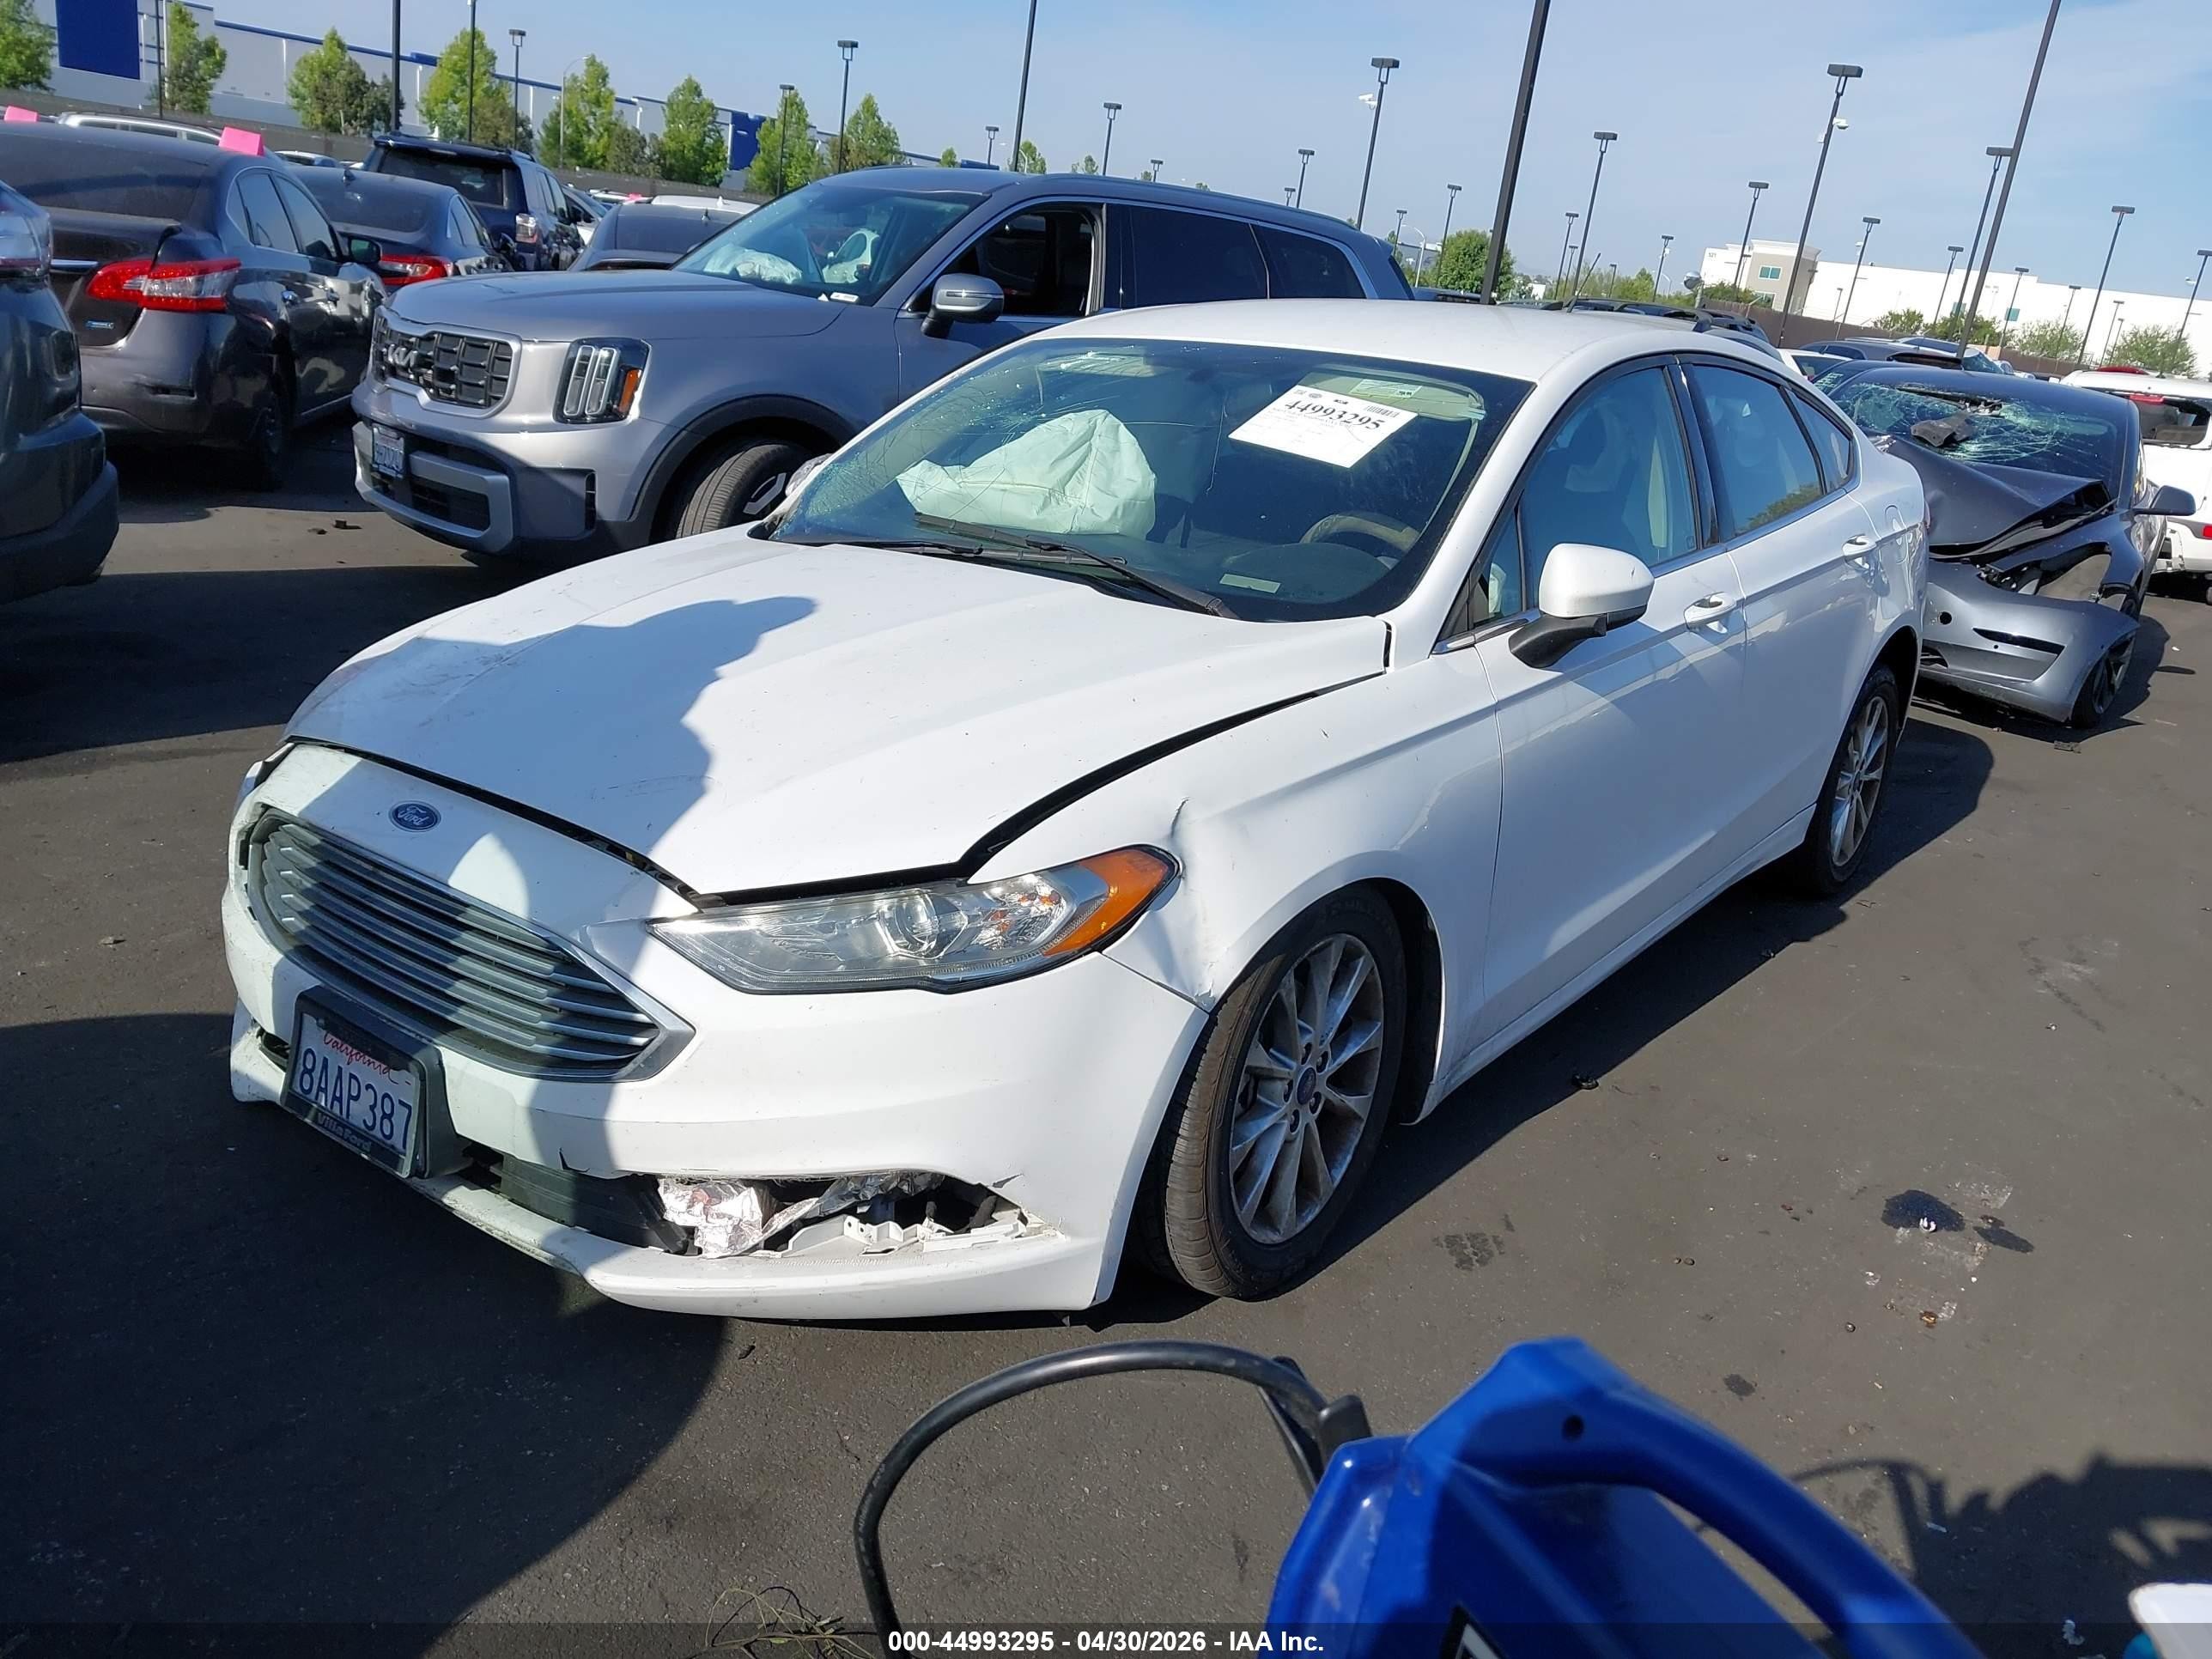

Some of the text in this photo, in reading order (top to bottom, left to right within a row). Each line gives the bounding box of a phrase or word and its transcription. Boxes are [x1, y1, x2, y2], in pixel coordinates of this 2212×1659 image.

[1285, 399, 1386, 430] 44993295
[397, 805, 429, 826] Ford
[299, 1048, 413, 1150] 8AAP387
